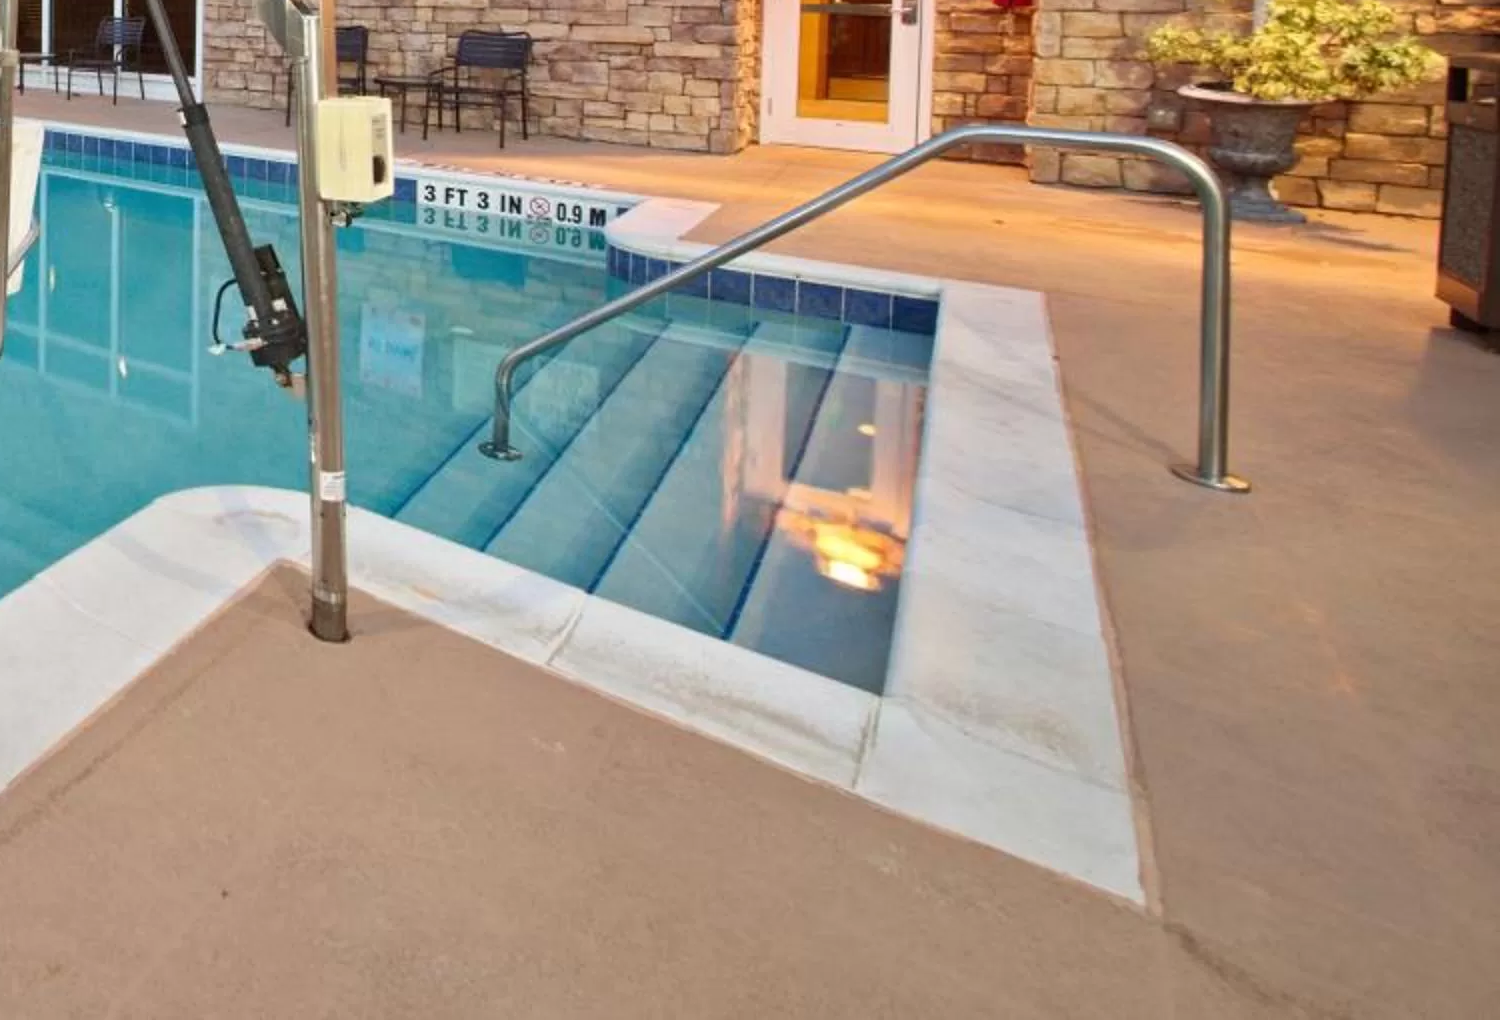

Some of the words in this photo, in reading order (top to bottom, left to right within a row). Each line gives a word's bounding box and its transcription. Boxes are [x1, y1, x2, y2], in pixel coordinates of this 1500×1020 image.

[424, 185, 436, 202] 3
[444, 187, 468, 206] FT
[477, 192, 489, 209] 3
[500, 193, 522, 215] IN
[556, 203, 582, 224] 0.9
[589, 207, 607, 227] M
